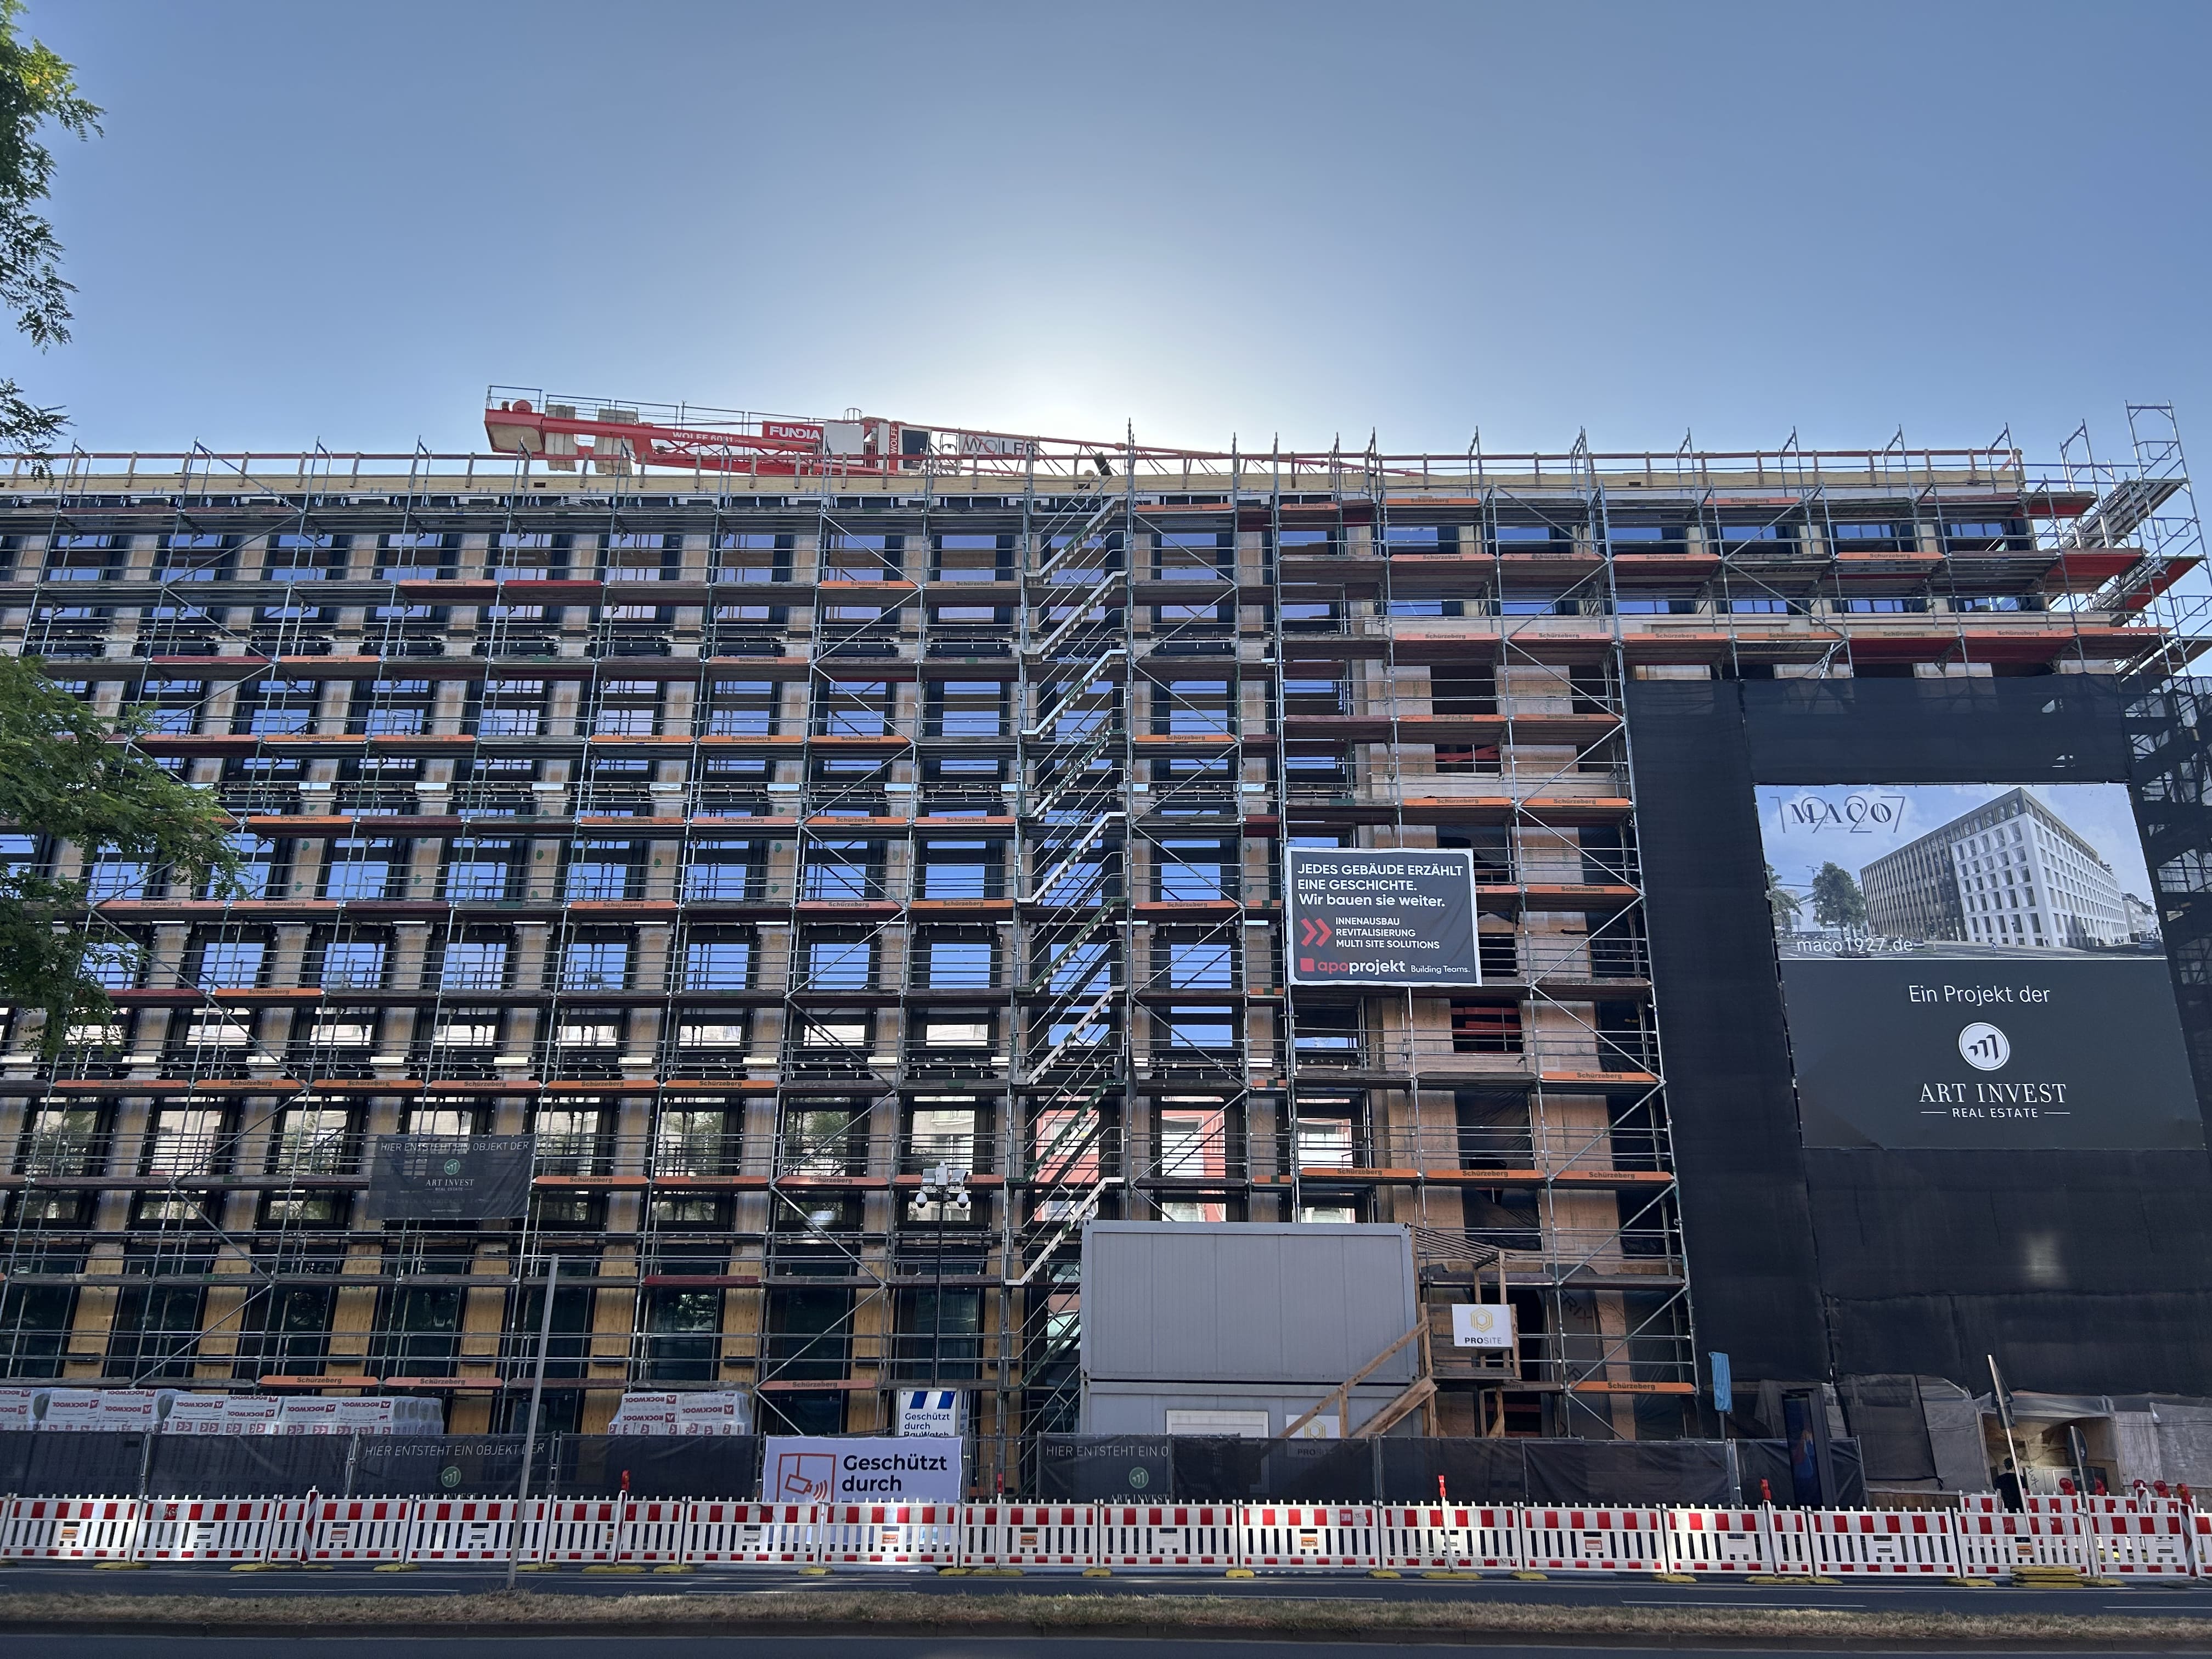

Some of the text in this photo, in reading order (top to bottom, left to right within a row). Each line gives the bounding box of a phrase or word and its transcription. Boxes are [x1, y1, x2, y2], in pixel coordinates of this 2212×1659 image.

[672, 432, 708, 440] WOLFF
[1789, 803, 1892, 823] MACO
[1297, 862, 1463, 876] JEDES GEBÄUDE ERZÄHLT
[1297, 879, 1417, 891] EINE GESCHICHTE.
[1299, 893, 1445, 907] Wir bauen sie weiter.
[1335, 917, 1400, 926] INNENAUSBAU
[1336, 929, 1416, 937] REVITALISIERUNG
[1365, 940, 1385, 948] SITE
[1387, 940, 1440, 949] SOLUTIONS
[1796, 936, 1914, 953] maco1927.de
[1318, 960, 1406, 975] apoprojekt
[1410, 965, 1442, 974] Building
[1910, 985, 2050, 1007] Ein Projekt der
[1919, 1083, 2067, 1104] ART INVEST
[1953, 1108, 2039, 1118] REAL ESTATE
[381, 1141, 529, 1152] HIER ENTSTEHT EIN OBJEKT DER
[905, 1412, 950, 1420] Geschützt
[365, 1444, 392, 1457] HIER
[394, 1444, 452, 1457] ENTSTEHT
[454, 1444, 473, 1455] EIN
[476, 1443, 519, 1455] OBJEKT
[1046, 1446, 1073, 1457] HIER
[1077, 1446, 1135, 1457] ENTSTEHT
[1139, 1446, 1157, 1457] EIN
[843, 1454, 947, 1471] Geschützt
[842, 1475, 902, 1492] durch
[1110, 1494, 1130, 1503] ART
